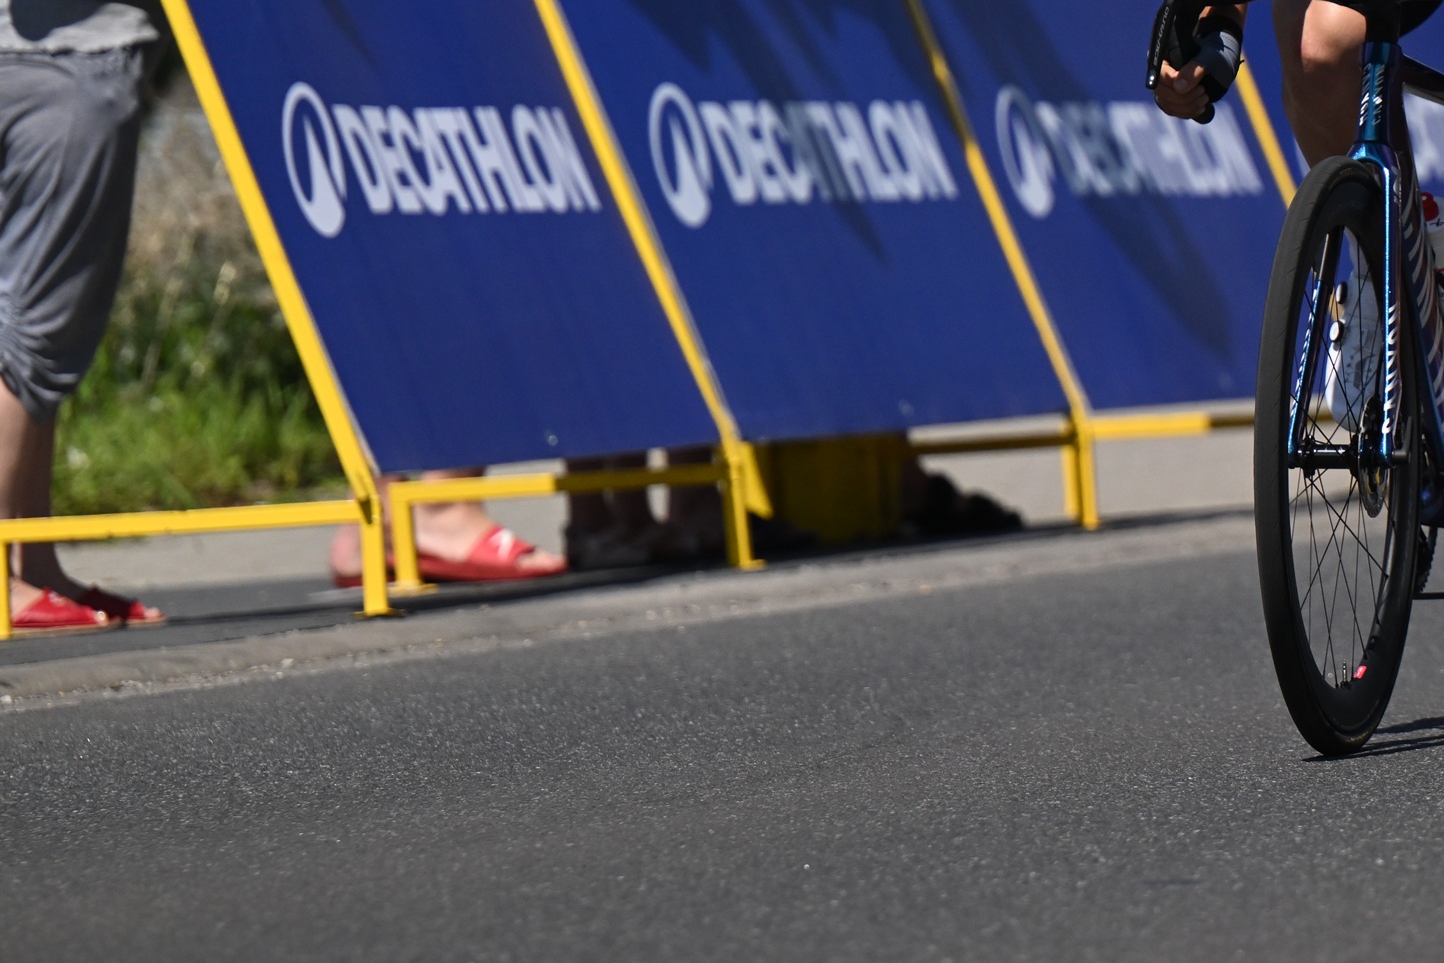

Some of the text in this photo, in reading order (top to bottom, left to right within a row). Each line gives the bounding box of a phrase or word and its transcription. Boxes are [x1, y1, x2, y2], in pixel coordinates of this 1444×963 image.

[332, 103, 600, 215] DECATHLON
[702, 98, 958, 204] DECATHLON
[1034, 99, 1264, 198] DECATHLON
